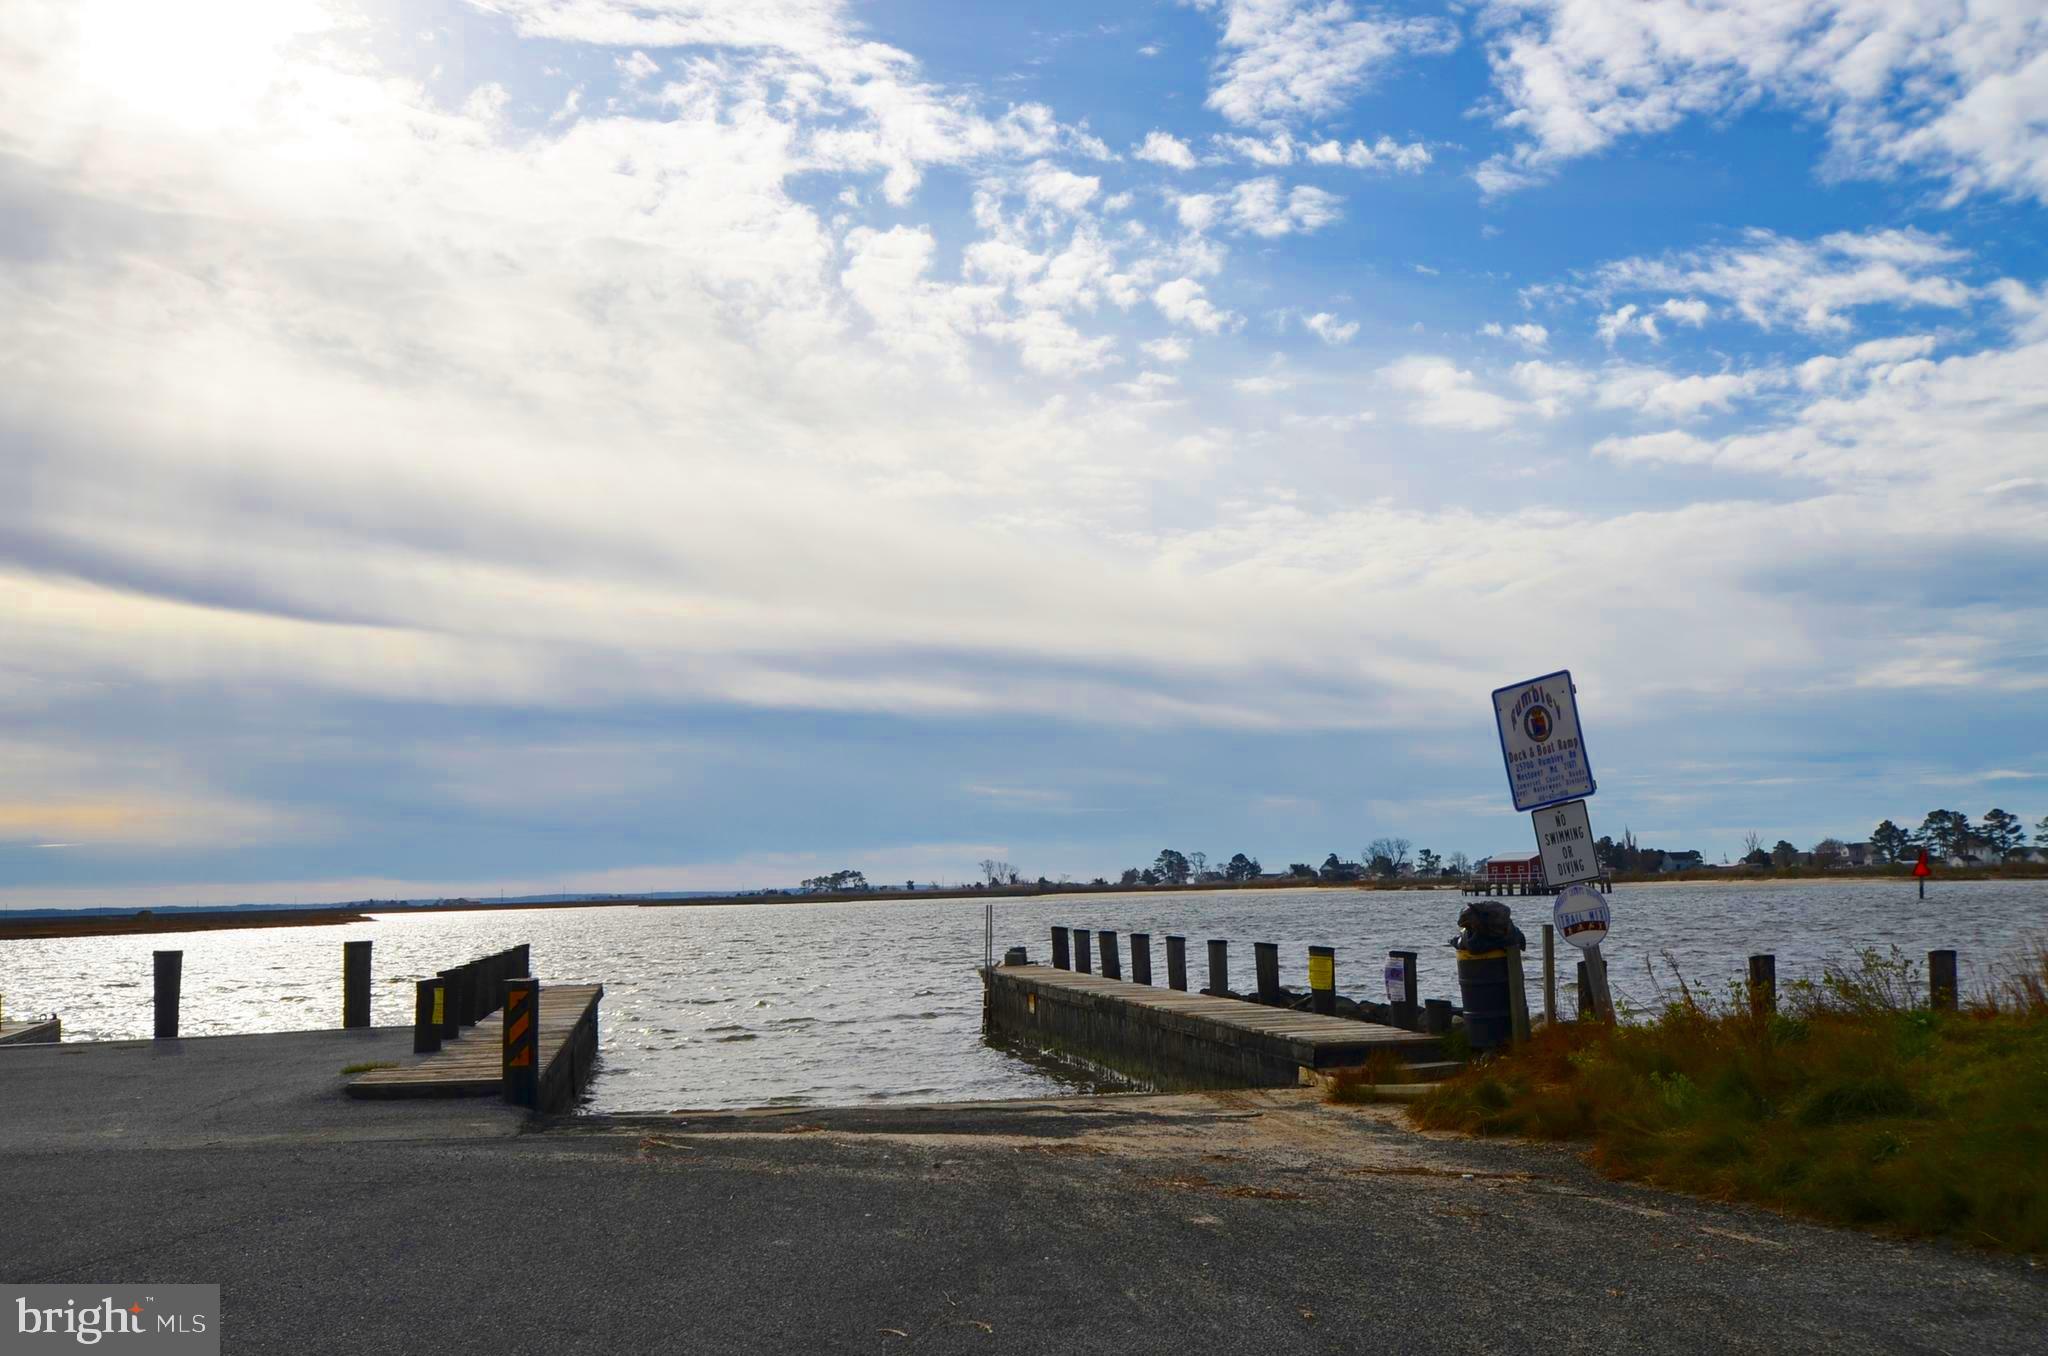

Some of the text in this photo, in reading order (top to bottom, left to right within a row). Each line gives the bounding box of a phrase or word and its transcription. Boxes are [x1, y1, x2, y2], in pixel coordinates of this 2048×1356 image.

[1508, 737, 1579, 763] Dock & Boat Ramp
[1555, 814, 1567, 827] NO
[1544, 826, 1584, 846] SWIMMING
[1562, 845, 1574, 859] OR
[1557, 858, 1585, 876] DIVING
[1560, 909, 1604, 927] TRAIL MIX
